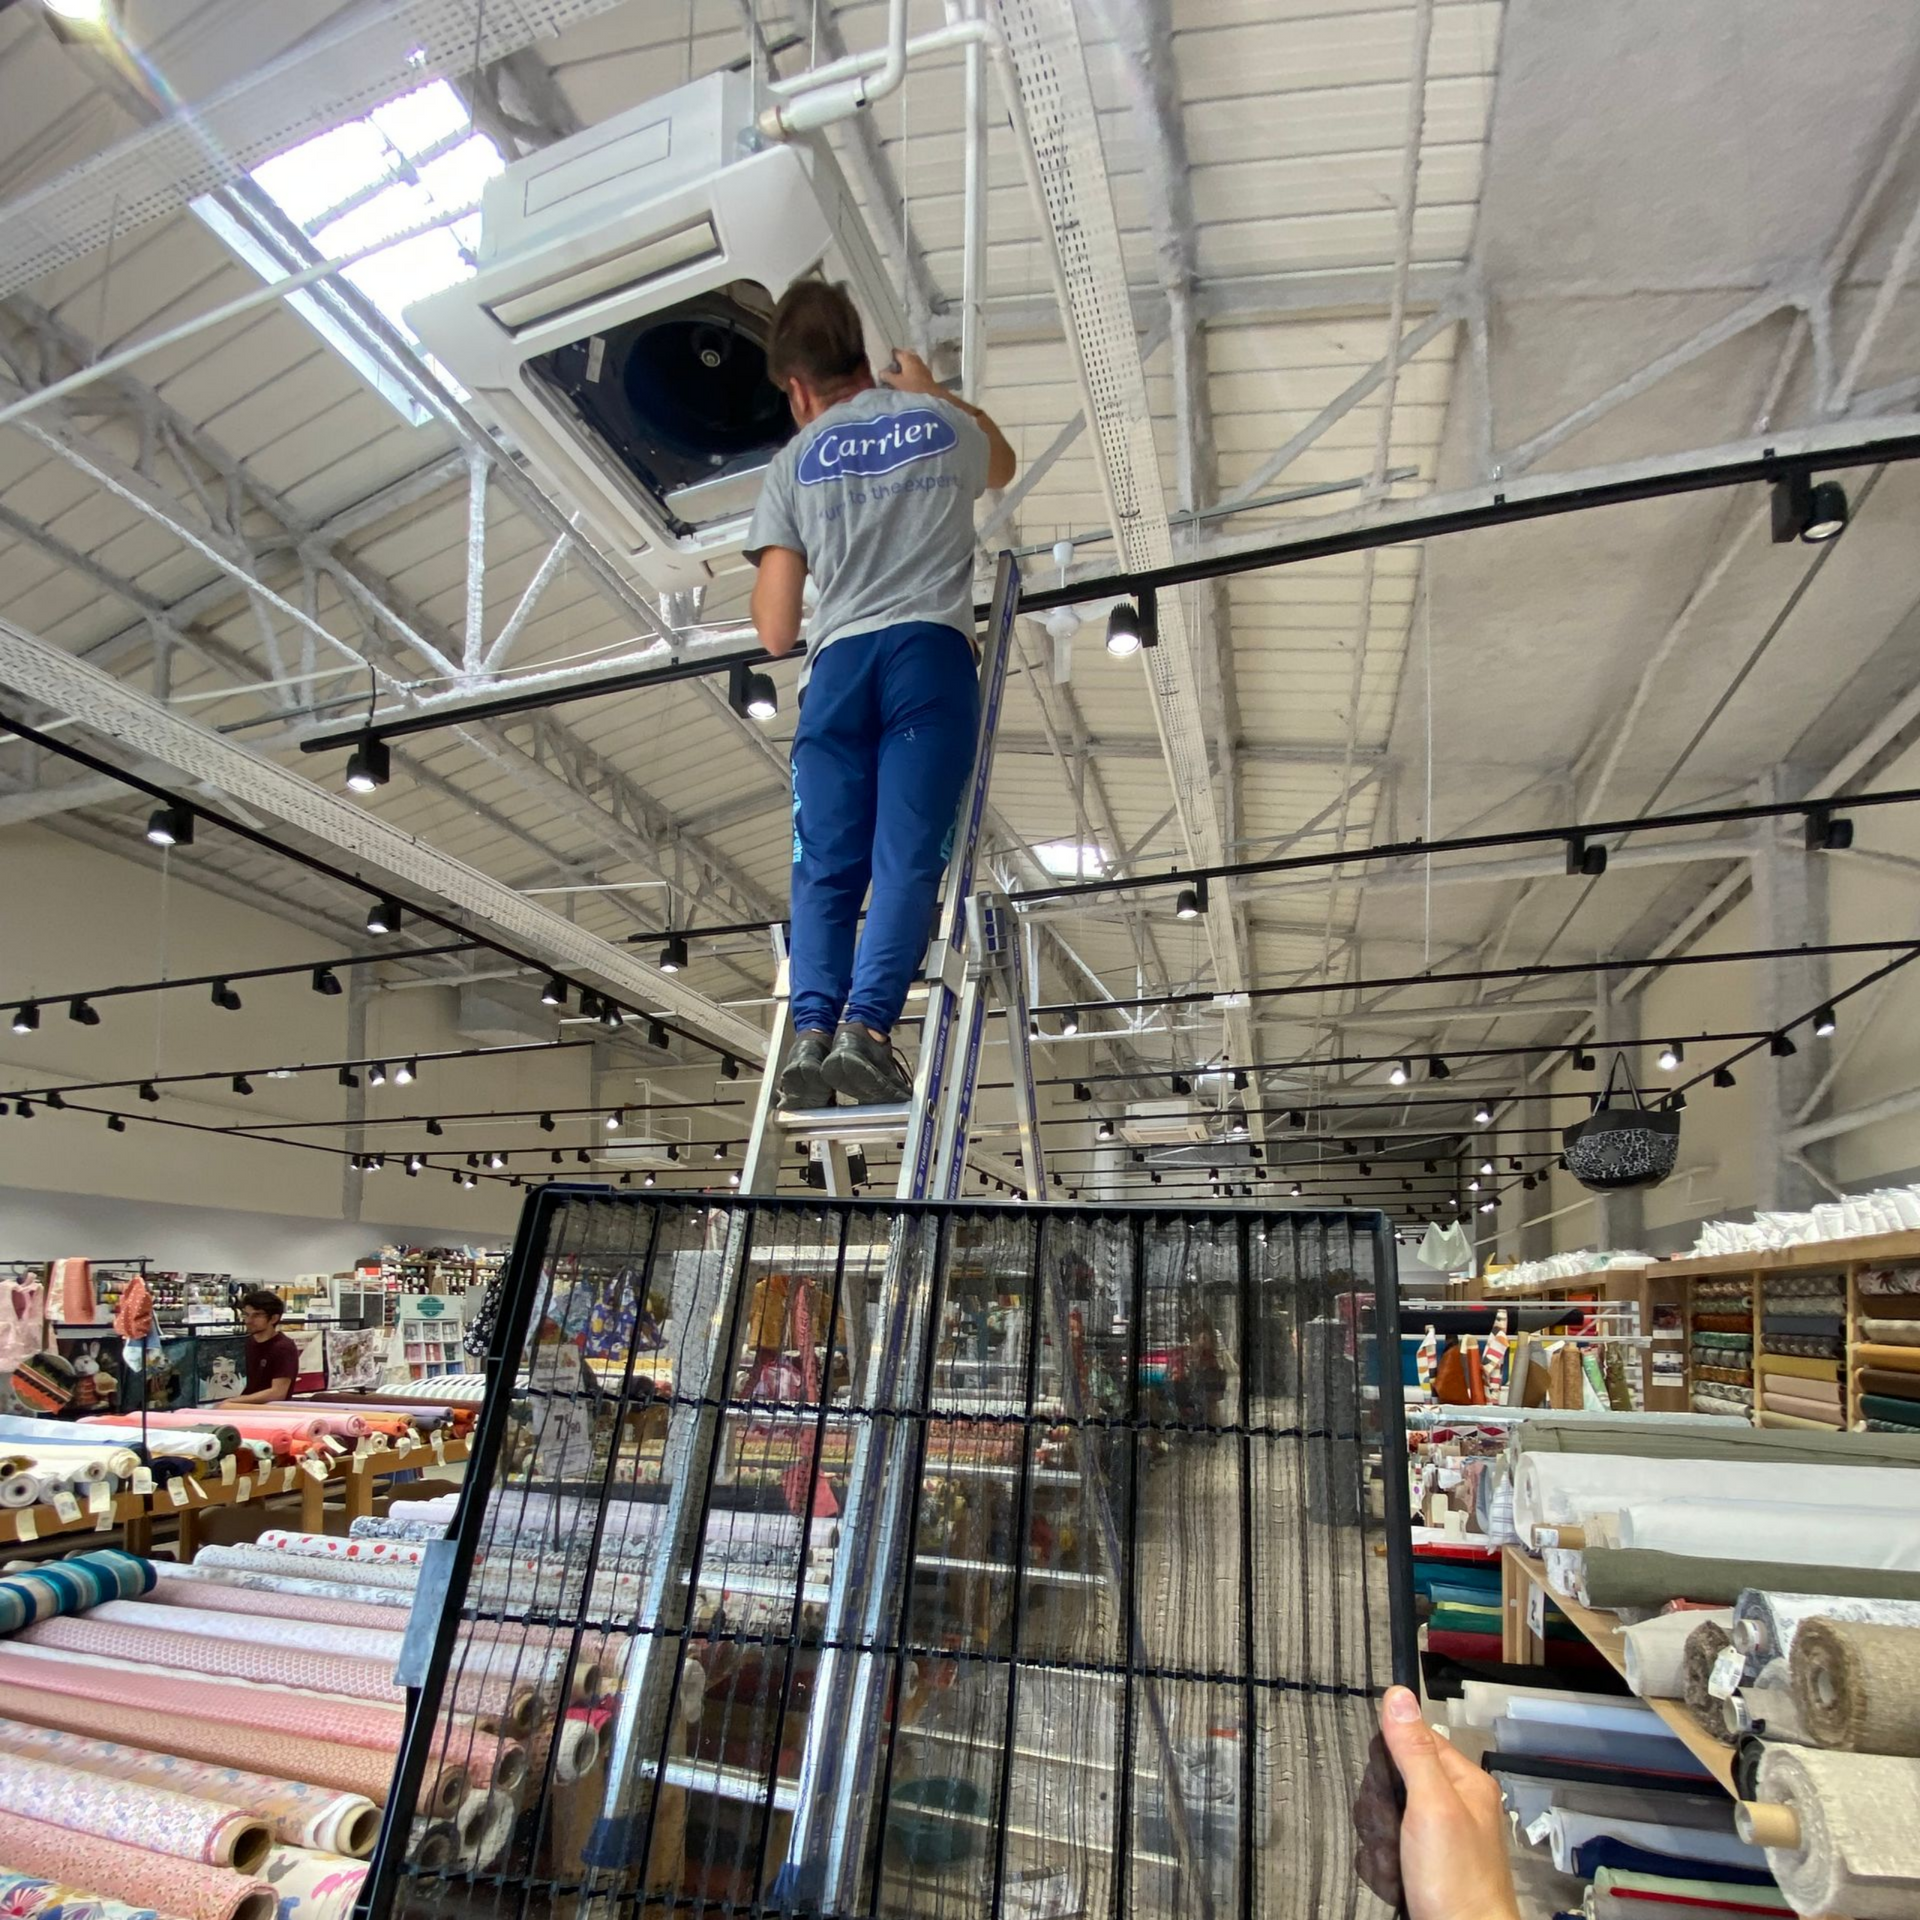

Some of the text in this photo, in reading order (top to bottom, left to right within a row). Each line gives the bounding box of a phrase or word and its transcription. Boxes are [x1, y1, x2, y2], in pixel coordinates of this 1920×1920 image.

[818, 422, 939, 467] Carrier
[849, 491, 867, 505] to
[872, 484, 903, 500] the
[934, 1029, 947, 1077] TUBESCA
[966, 1043, 977, 1089] TUBESCA
[920, 1121, 932, 1171] TUBESCA
[949, 1160, 960, 1200] TUBESC
